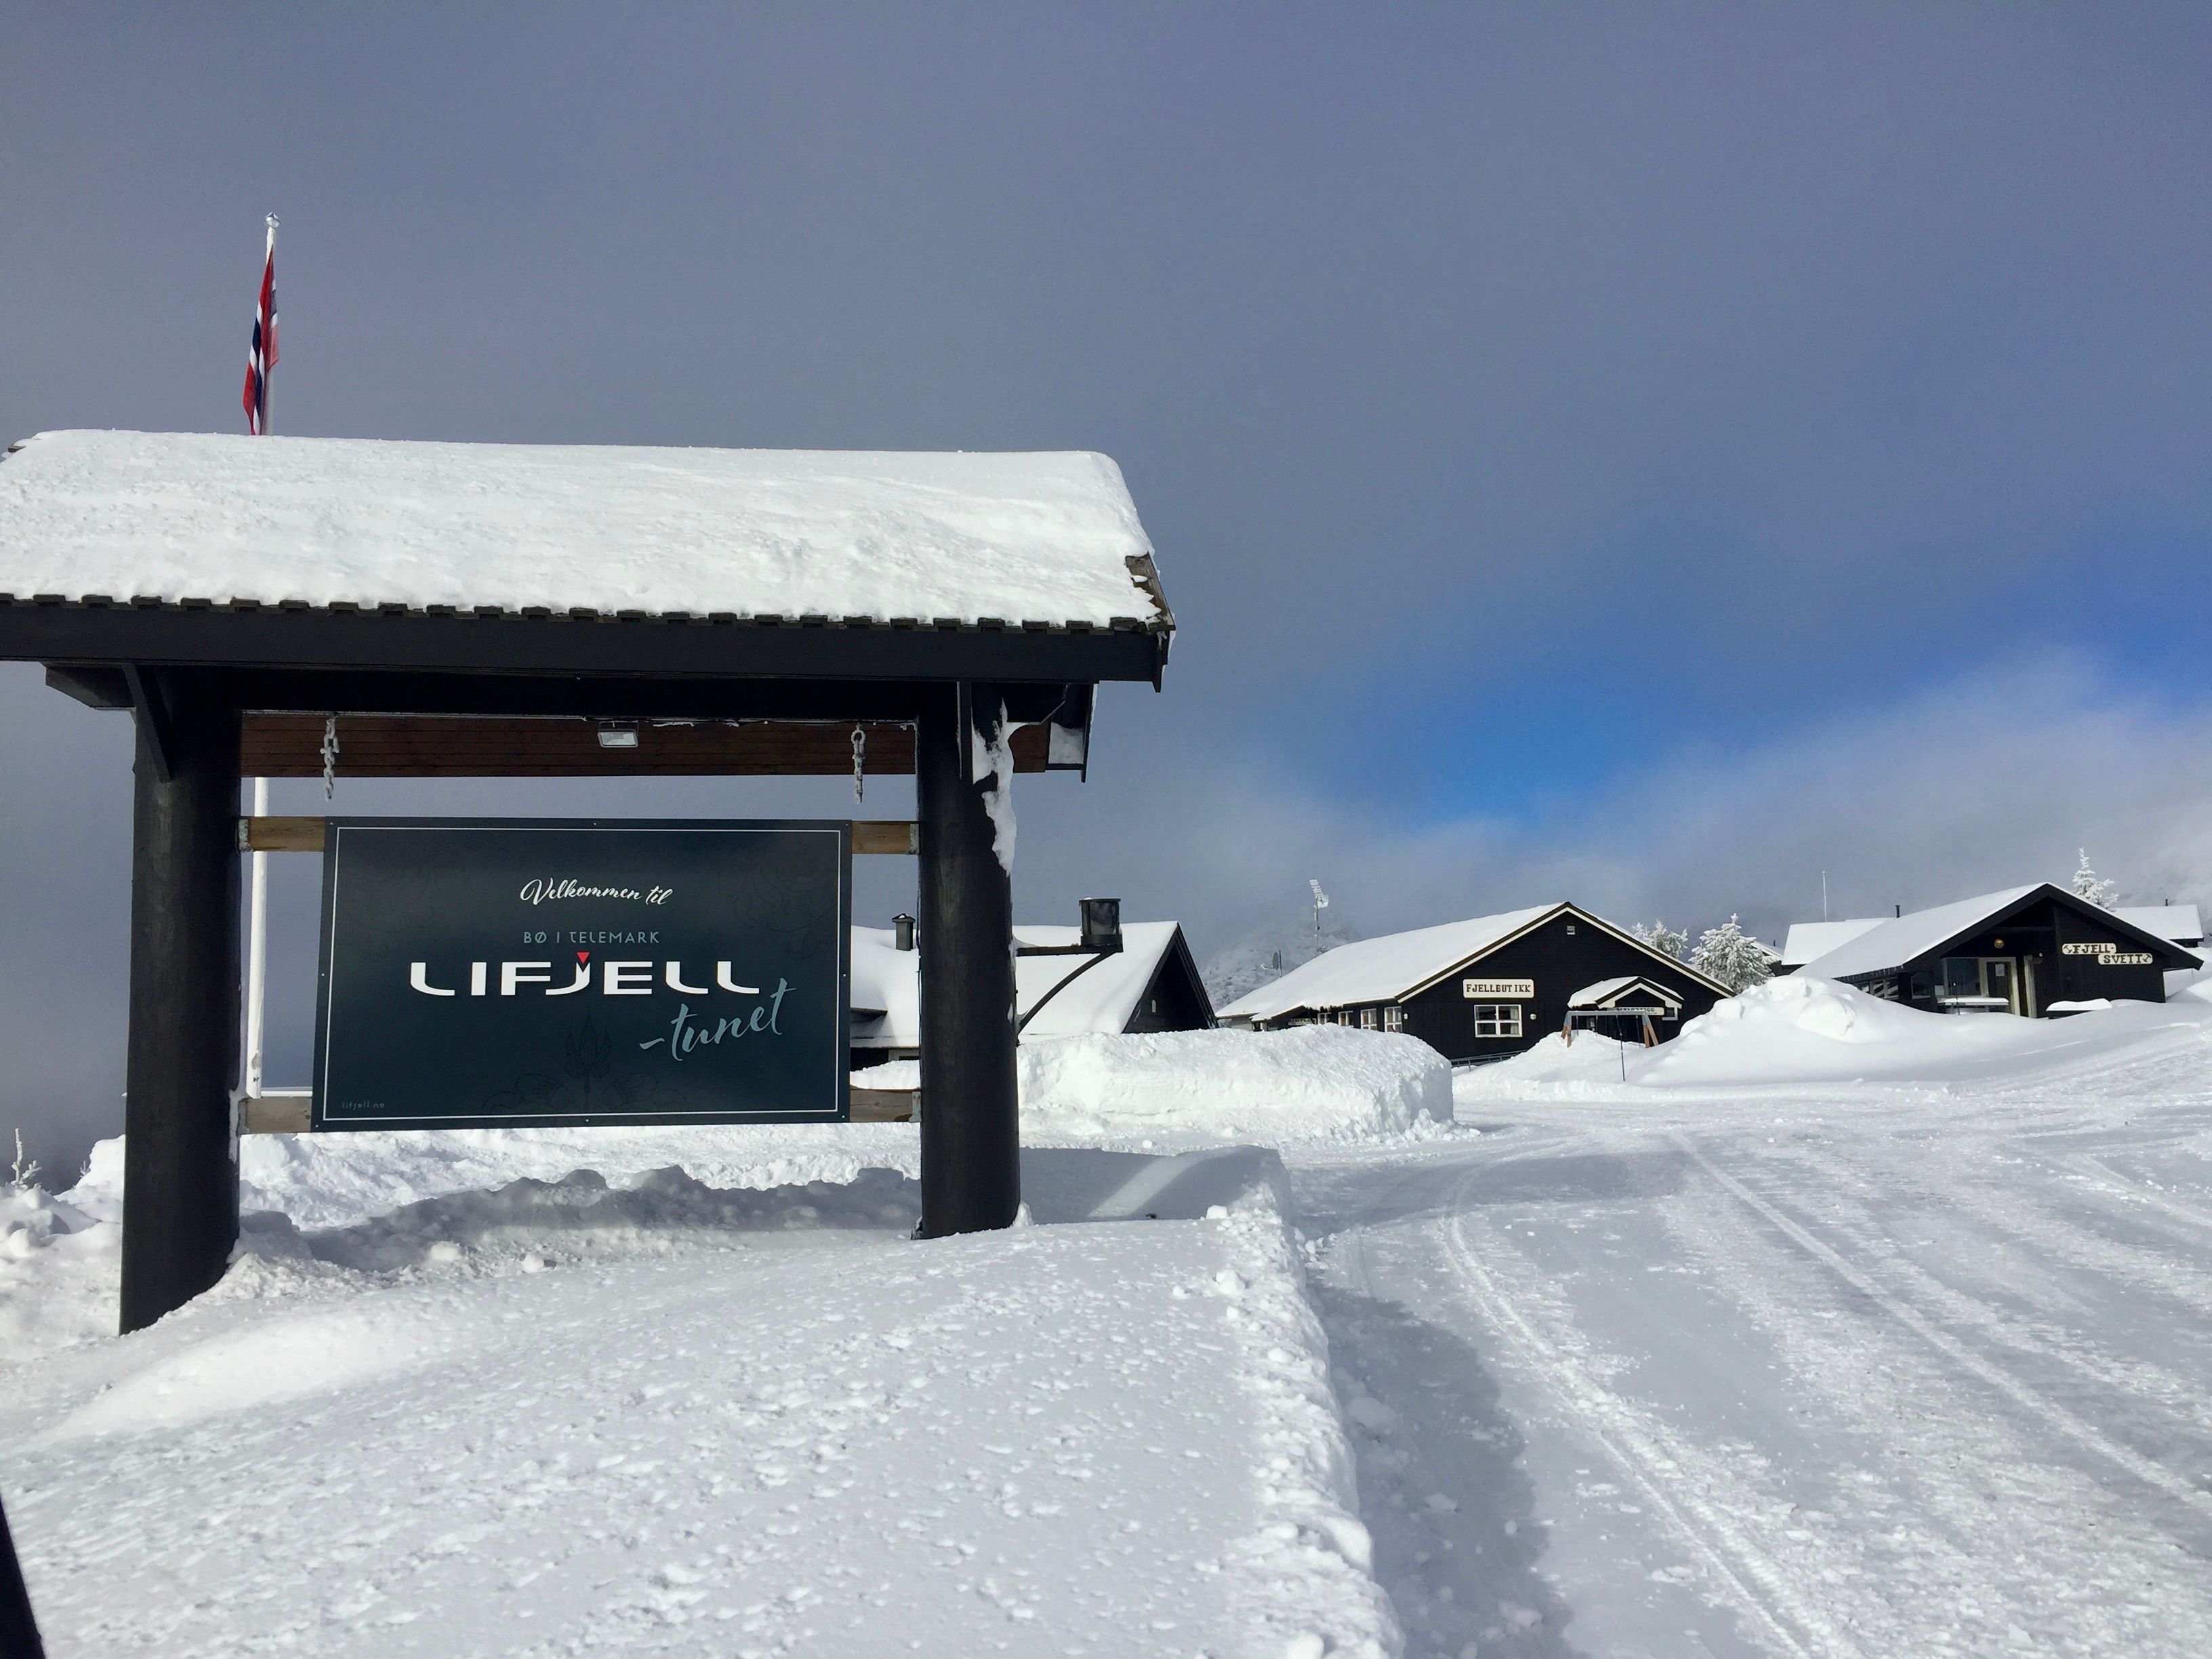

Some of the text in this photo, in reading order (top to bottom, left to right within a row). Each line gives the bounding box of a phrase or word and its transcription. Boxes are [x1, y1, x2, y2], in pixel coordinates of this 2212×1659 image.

[520, 877, 673, 905] Velkommen til
[524, 931, 659, 943] BØ I TELEMARK
[2104, 954, 2142, 964] SVETT
[410, 961, 760, 996] LIFJELL
[1466, 984, 1531, 993] FJELLBUTIKK
[639, 978, 796, 1061] -tunet
